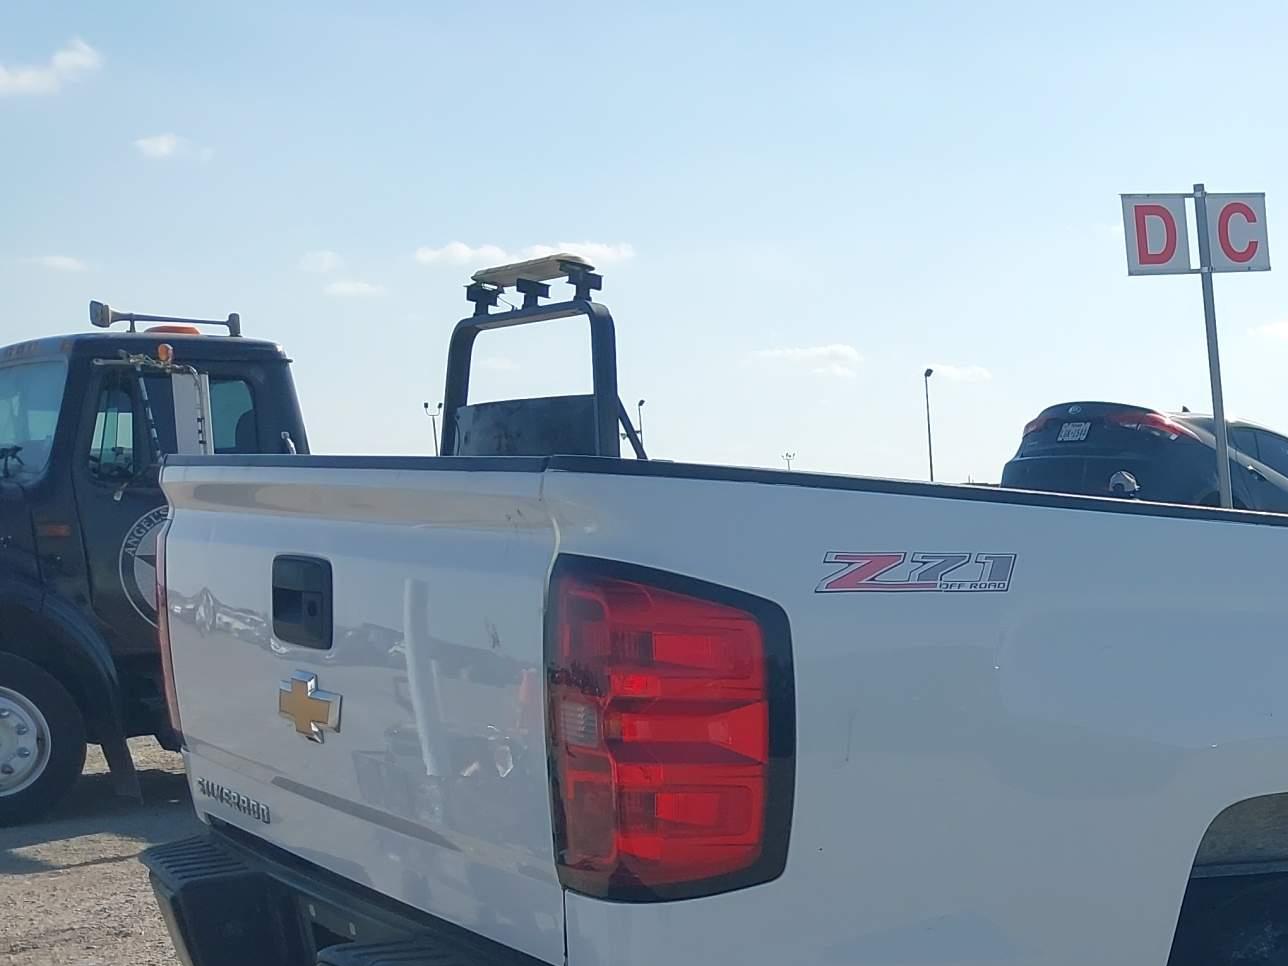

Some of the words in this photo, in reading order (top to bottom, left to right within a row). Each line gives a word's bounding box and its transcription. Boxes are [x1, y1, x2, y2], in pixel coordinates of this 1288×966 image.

[1134, 204, 1178, 265] D
[1218, 202, 1259, 263] C
[815, 551, 1017, 593] Z71
[939, 582, 968, 590] OFF
[970, 582, 1006, 590] ROAD
[198, 777, 271, 825] SILVERADO
